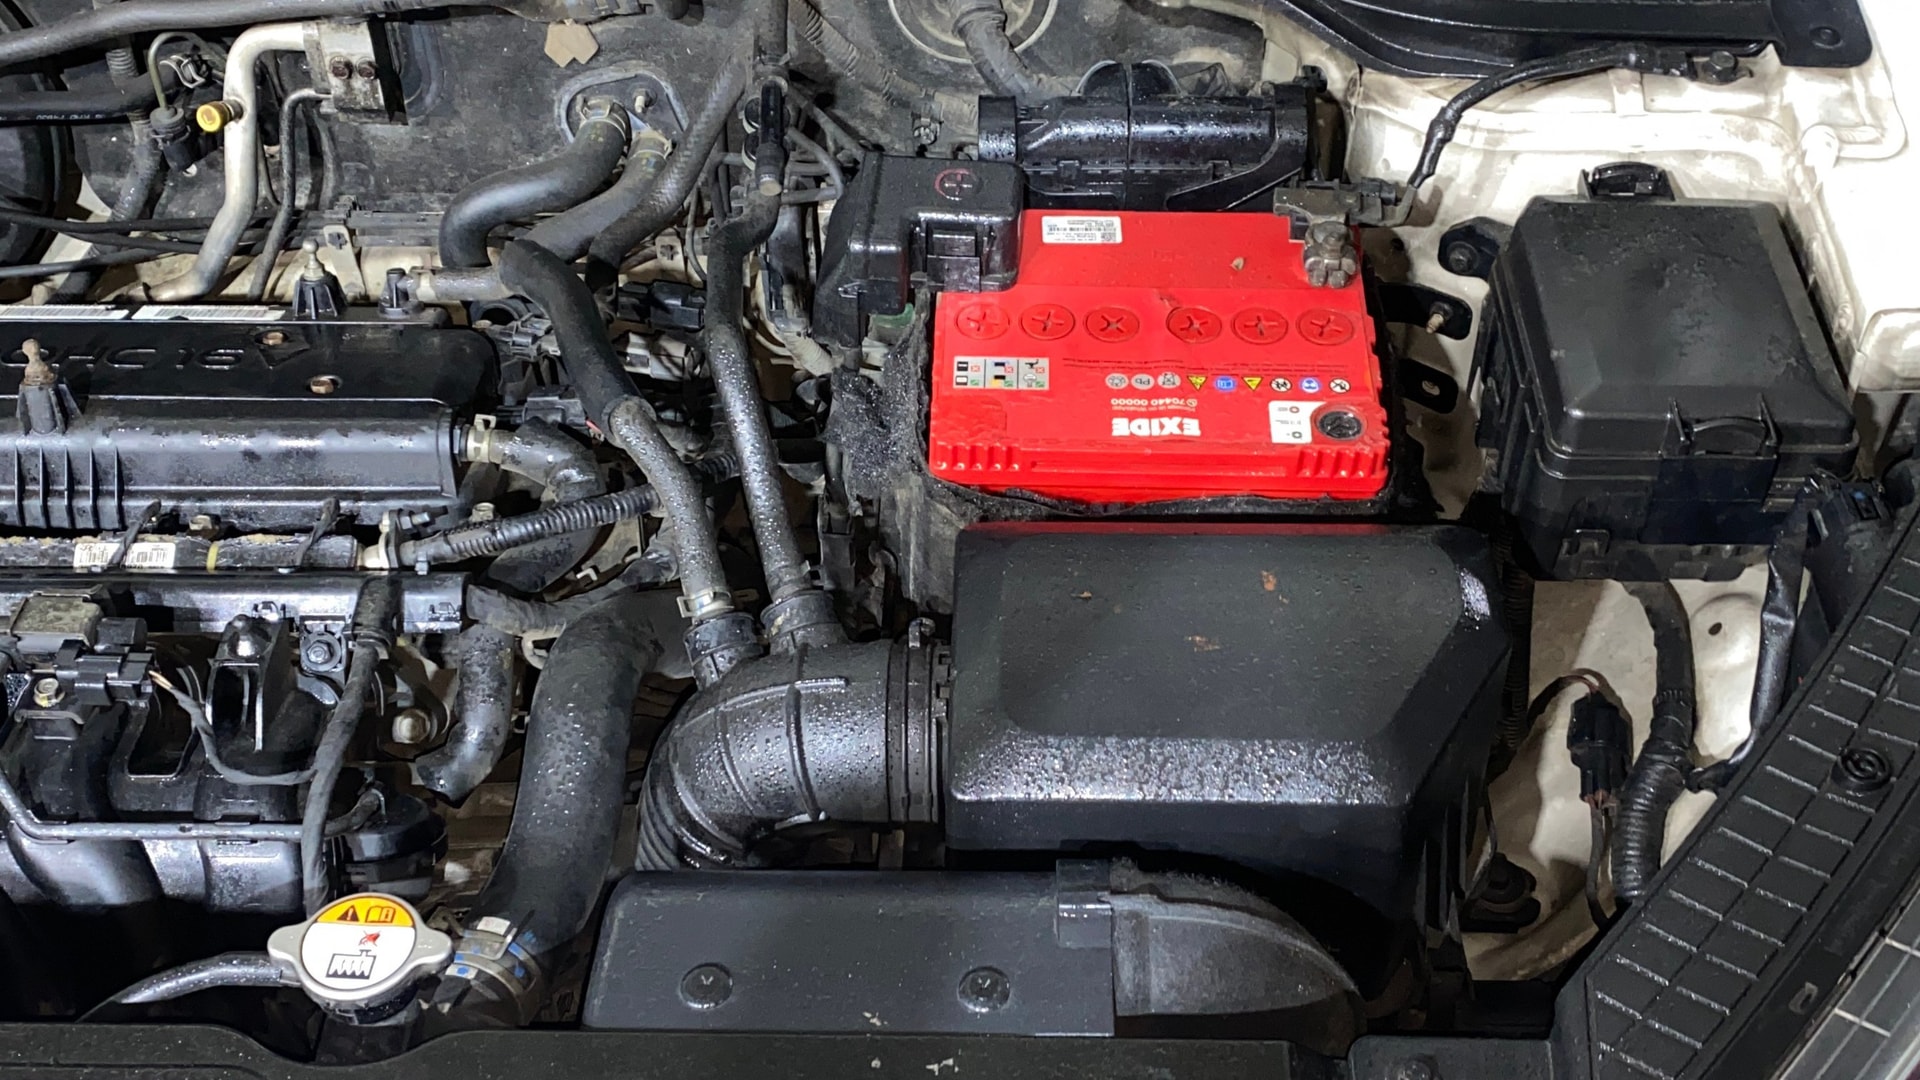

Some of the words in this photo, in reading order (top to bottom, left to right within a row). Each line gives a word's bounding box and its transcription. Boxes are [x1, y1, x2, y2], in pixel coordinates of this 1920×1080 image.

[1135, 378, 1150, 386] Pb
[1151, 397, 1186, 406] 70440
[1111, 416, 1201, 437] EXIDE
